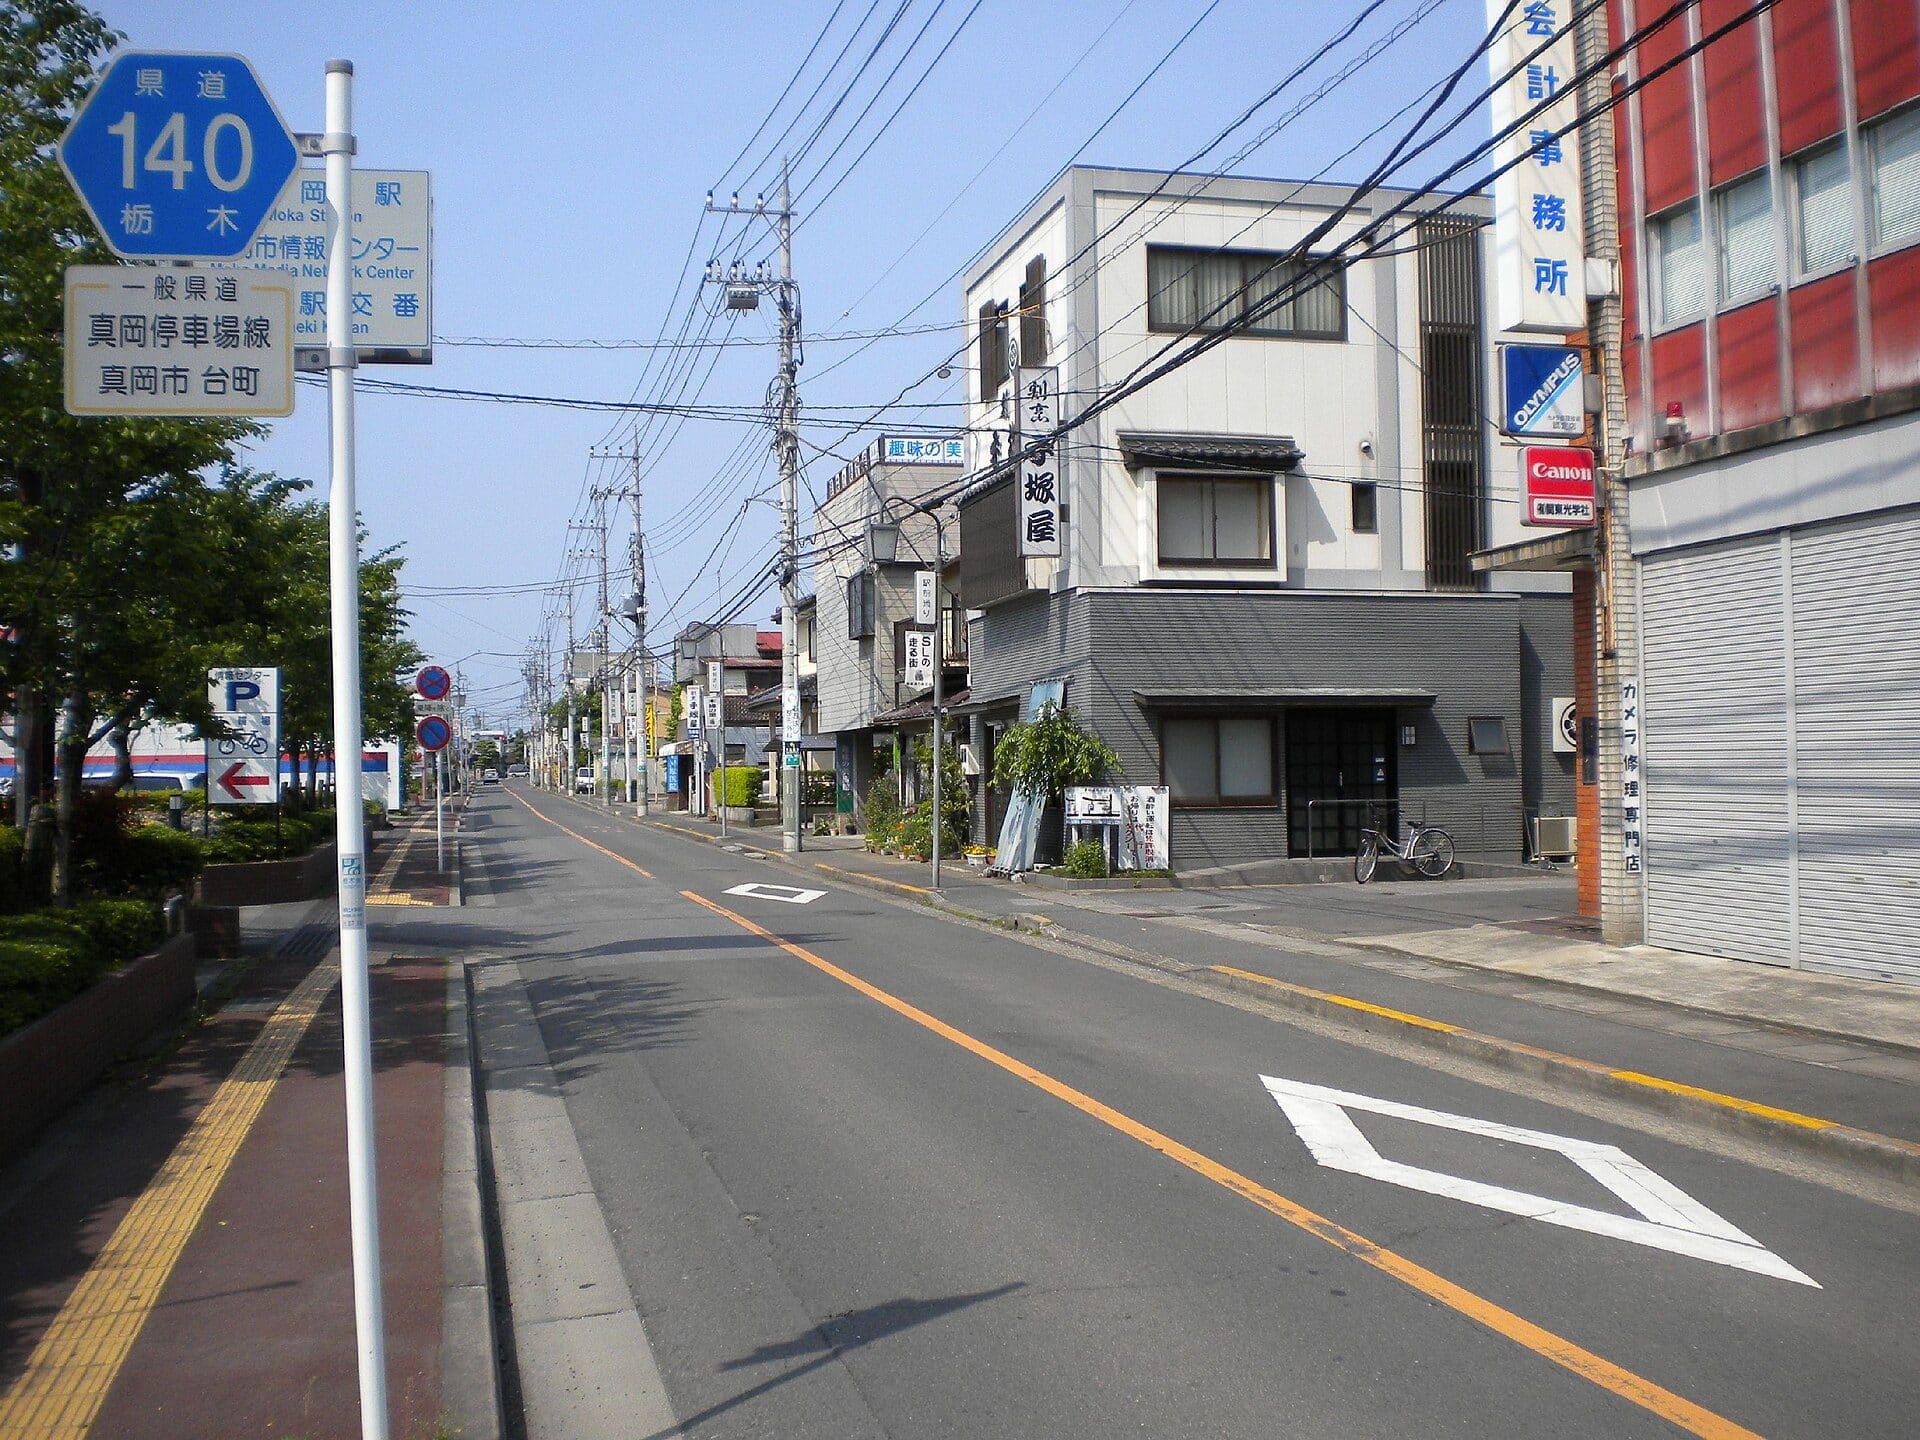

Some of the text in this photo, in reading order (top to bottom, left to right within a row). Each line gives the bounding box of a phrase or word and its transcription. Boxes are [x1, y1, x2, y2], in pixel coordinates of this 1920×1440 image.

[136, 69, 227, 99] 県道
[107, 112, 253, 192] 140
[1523, 0, 1569, 297] 会計事務所
[121, 204, 239, 237] 栃木
[246, 235, 419, 261] 市情報ンター
[302, 264, 361, 278] Netk
[366, 265, 415, 279] Center
[122, 276, 238, 302] 一般県道
[88, 313, 272, 349] 真岡停車場線
[293, 319, 315, 333] eki
[1513, 353, 1581, 426] OLYMPUS
[1532, 462, 1592, 481] Canon
[908, 637, 918, 668] 走る街
[921, 636, 931, 668] SLの
[226, 681, 260, 711] P
[1623, 683, 1640, 871] カメラ修理専門店
